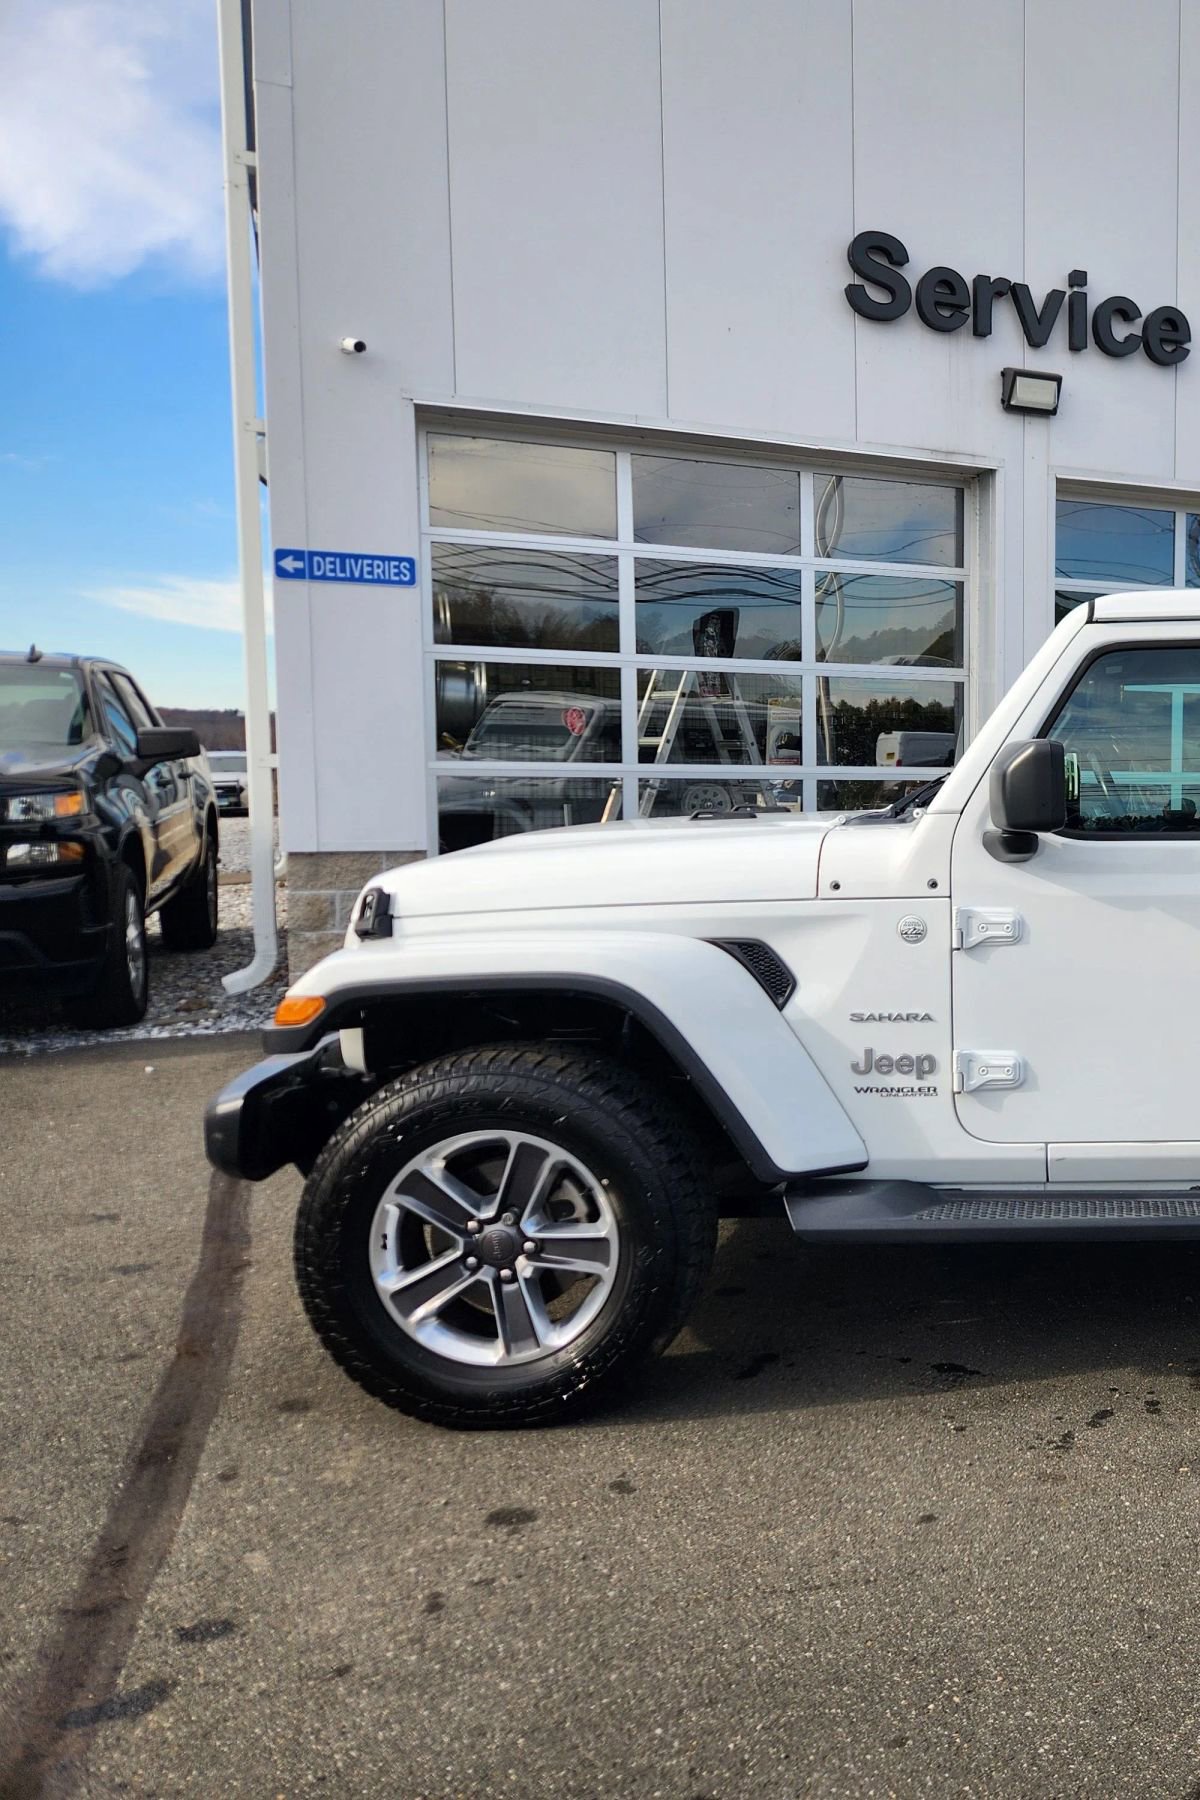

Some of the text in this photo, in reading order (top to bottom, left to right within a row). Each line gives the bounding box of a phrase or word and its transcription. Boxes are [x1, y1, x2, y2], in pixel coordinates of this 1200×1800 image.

[844, 230, 1192, 366] Service
[312, 555, 411, 581] DELIVERIES
[849, 1012, 935, 1022] SAHARA
[850, 1047, 937, 1081] Jeep
[854, 1086, 937, 1094] WRANGLER
